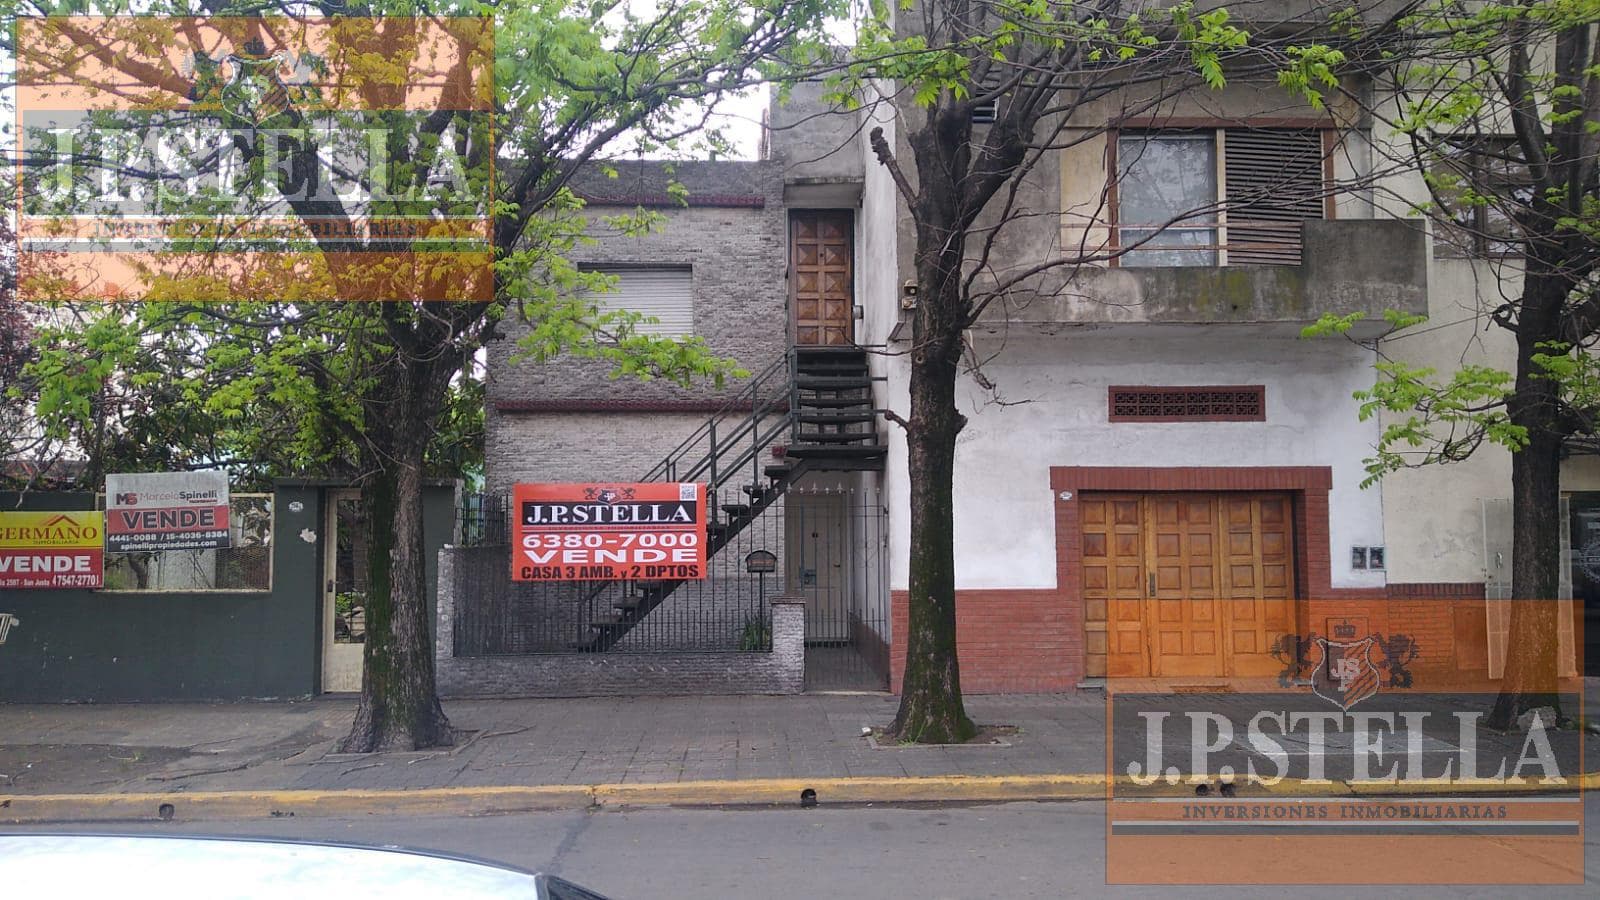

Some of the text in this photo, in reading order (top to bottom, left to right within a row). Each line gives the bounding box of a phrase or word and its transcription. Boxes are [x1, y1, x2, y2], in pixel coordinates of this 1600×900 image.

[123, 509, 214, 529] VENDE
[527, 504, 692, 524] J.P.STELLA
[0, 527, 97, 540] ERMANO
[522, 533, 698, 548] 6380-7000
[120, 540, 217, 551] spinellipropiedades.com
[523, 549, 698, 564] VENDE
[0, 556, 91, 573] VENDE
[521, 566, 562, 579] CASA
[565, 566, 575, 578] 3
[579, 566, 617, 579] AMB.
[631, 565, 641, 578] 2
[645, 564, 699, 578] DPTOS
